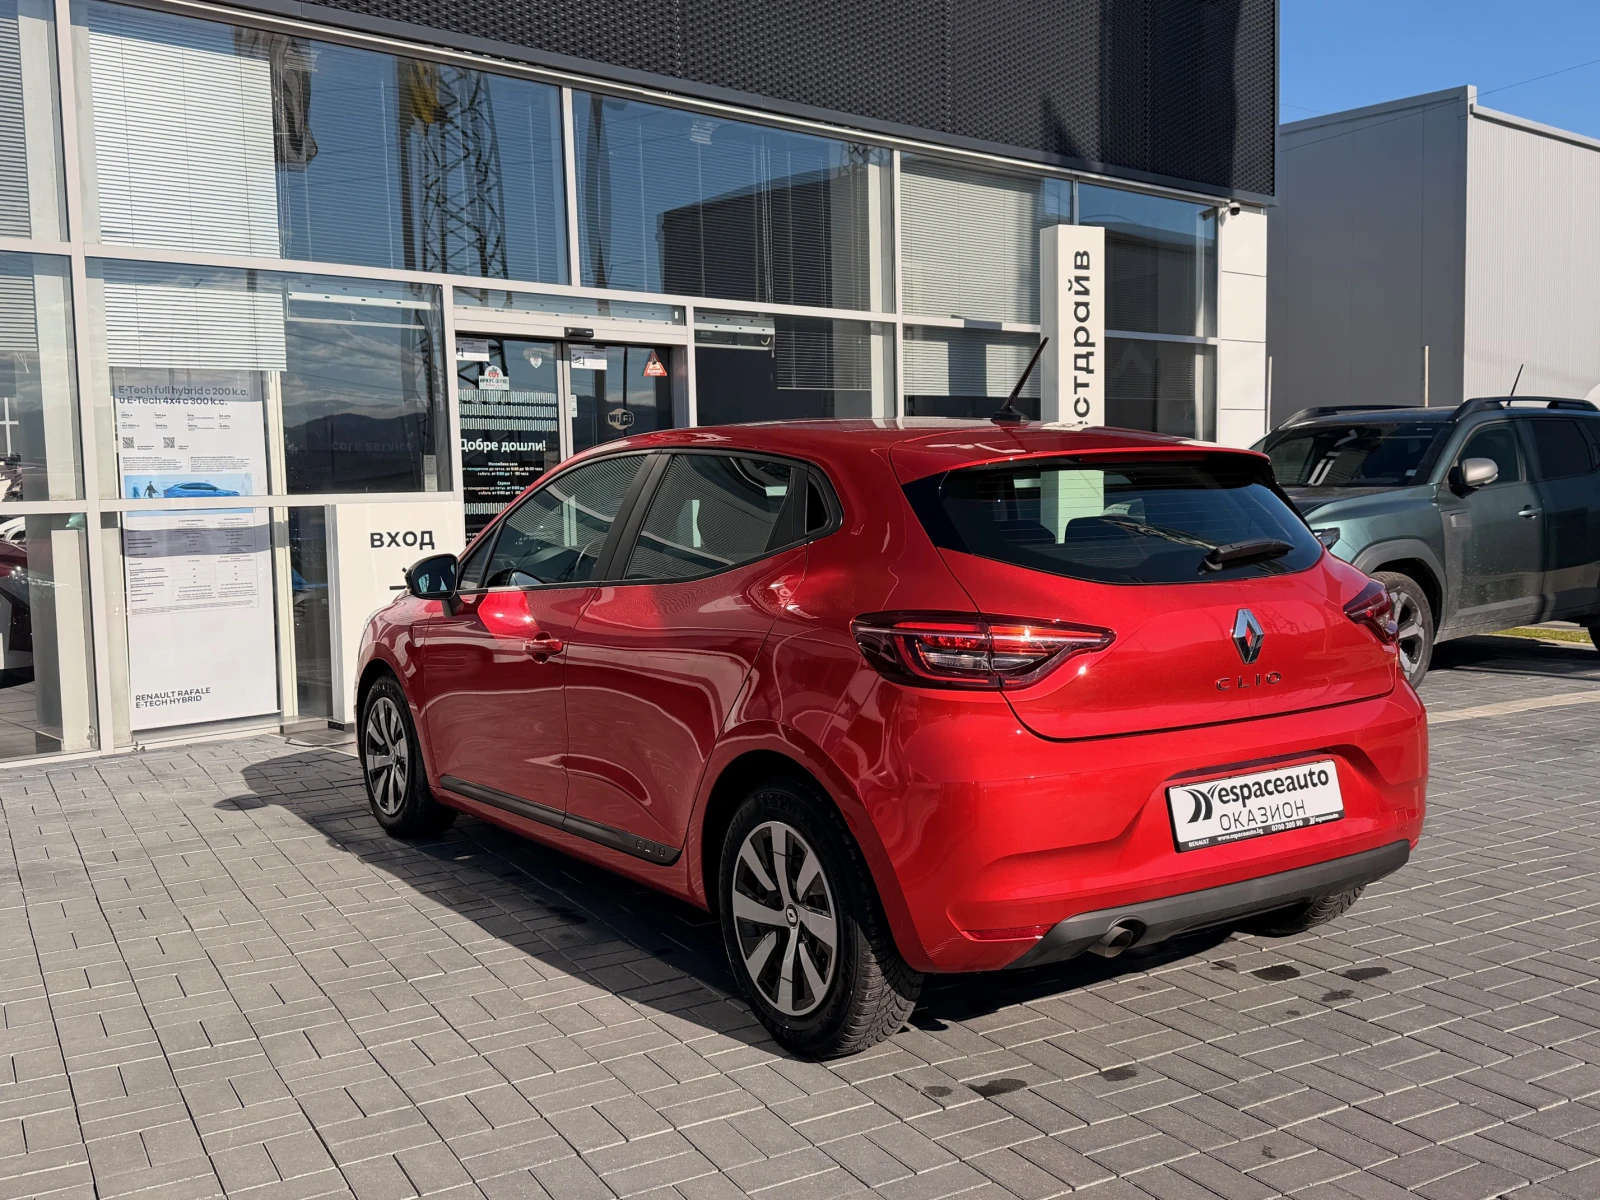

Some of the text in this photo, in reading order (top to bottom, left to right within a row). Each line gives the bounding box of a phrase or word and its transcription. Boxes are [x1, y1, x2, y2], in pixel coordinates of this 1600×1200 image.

[1066, 249, 1096, 425] стдрайв
[118, 385, 152, 394] E-Tech
[154, 385, 170, 394] full
[171, 386, 204, 396] hybrid
[212, 387, 231, 396] 200
[127, 396, 161, 404] E-Tech
[190, 397, 209, 405] 300
[366, 440, 413, 451] service
[460, 438, 546, 453] Добре дошли!
[370, 530, 435, 550] ВХОД
[1216, 671, 1281, 691] CLIO
[135, 686, 211, 702] RENAULT RAFALE
[135, 694, 202, 708] E-TECH HYBRID
[1217, 767, 1329, 808] espaceauto
[1219, 799, 1306, 831] ОКАЗИОН
[1188, 838, 1210, 848] RENAULT
[1217, 827, 1264, 842] www.espaceauto.bg
[1271, 823, 1285, 832] 0700
[635, 839, 666, 857] CLIO
